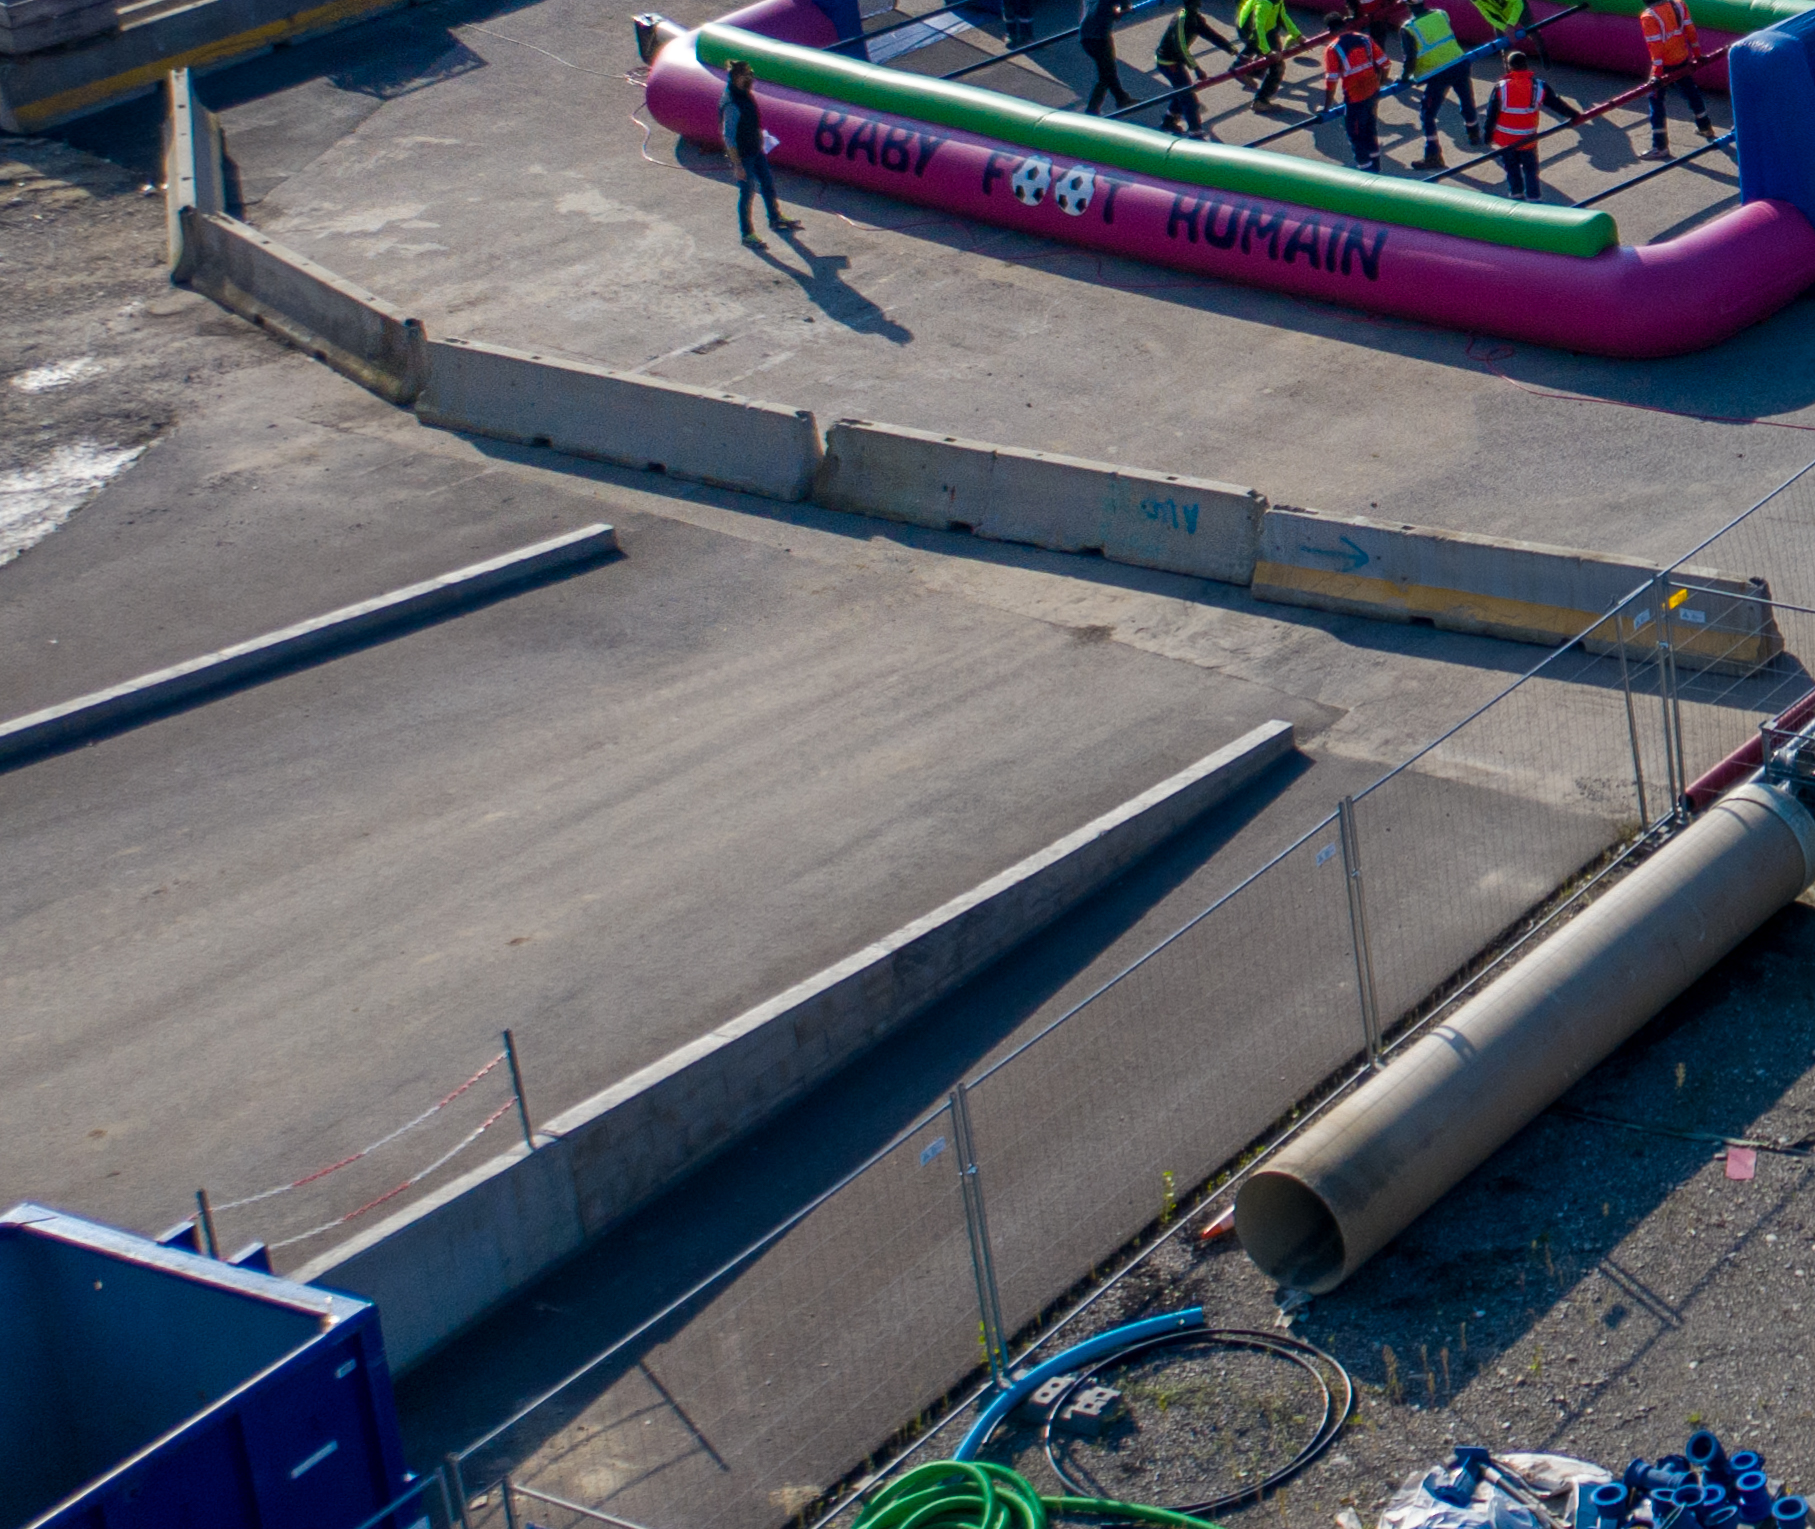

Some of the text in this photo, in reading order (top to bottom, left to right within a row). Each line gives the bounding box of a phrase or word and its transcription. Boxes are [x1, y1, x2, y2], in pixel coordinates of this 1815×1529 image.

[813, 103, 1389, 281] BABY FOOT HUMAIN
